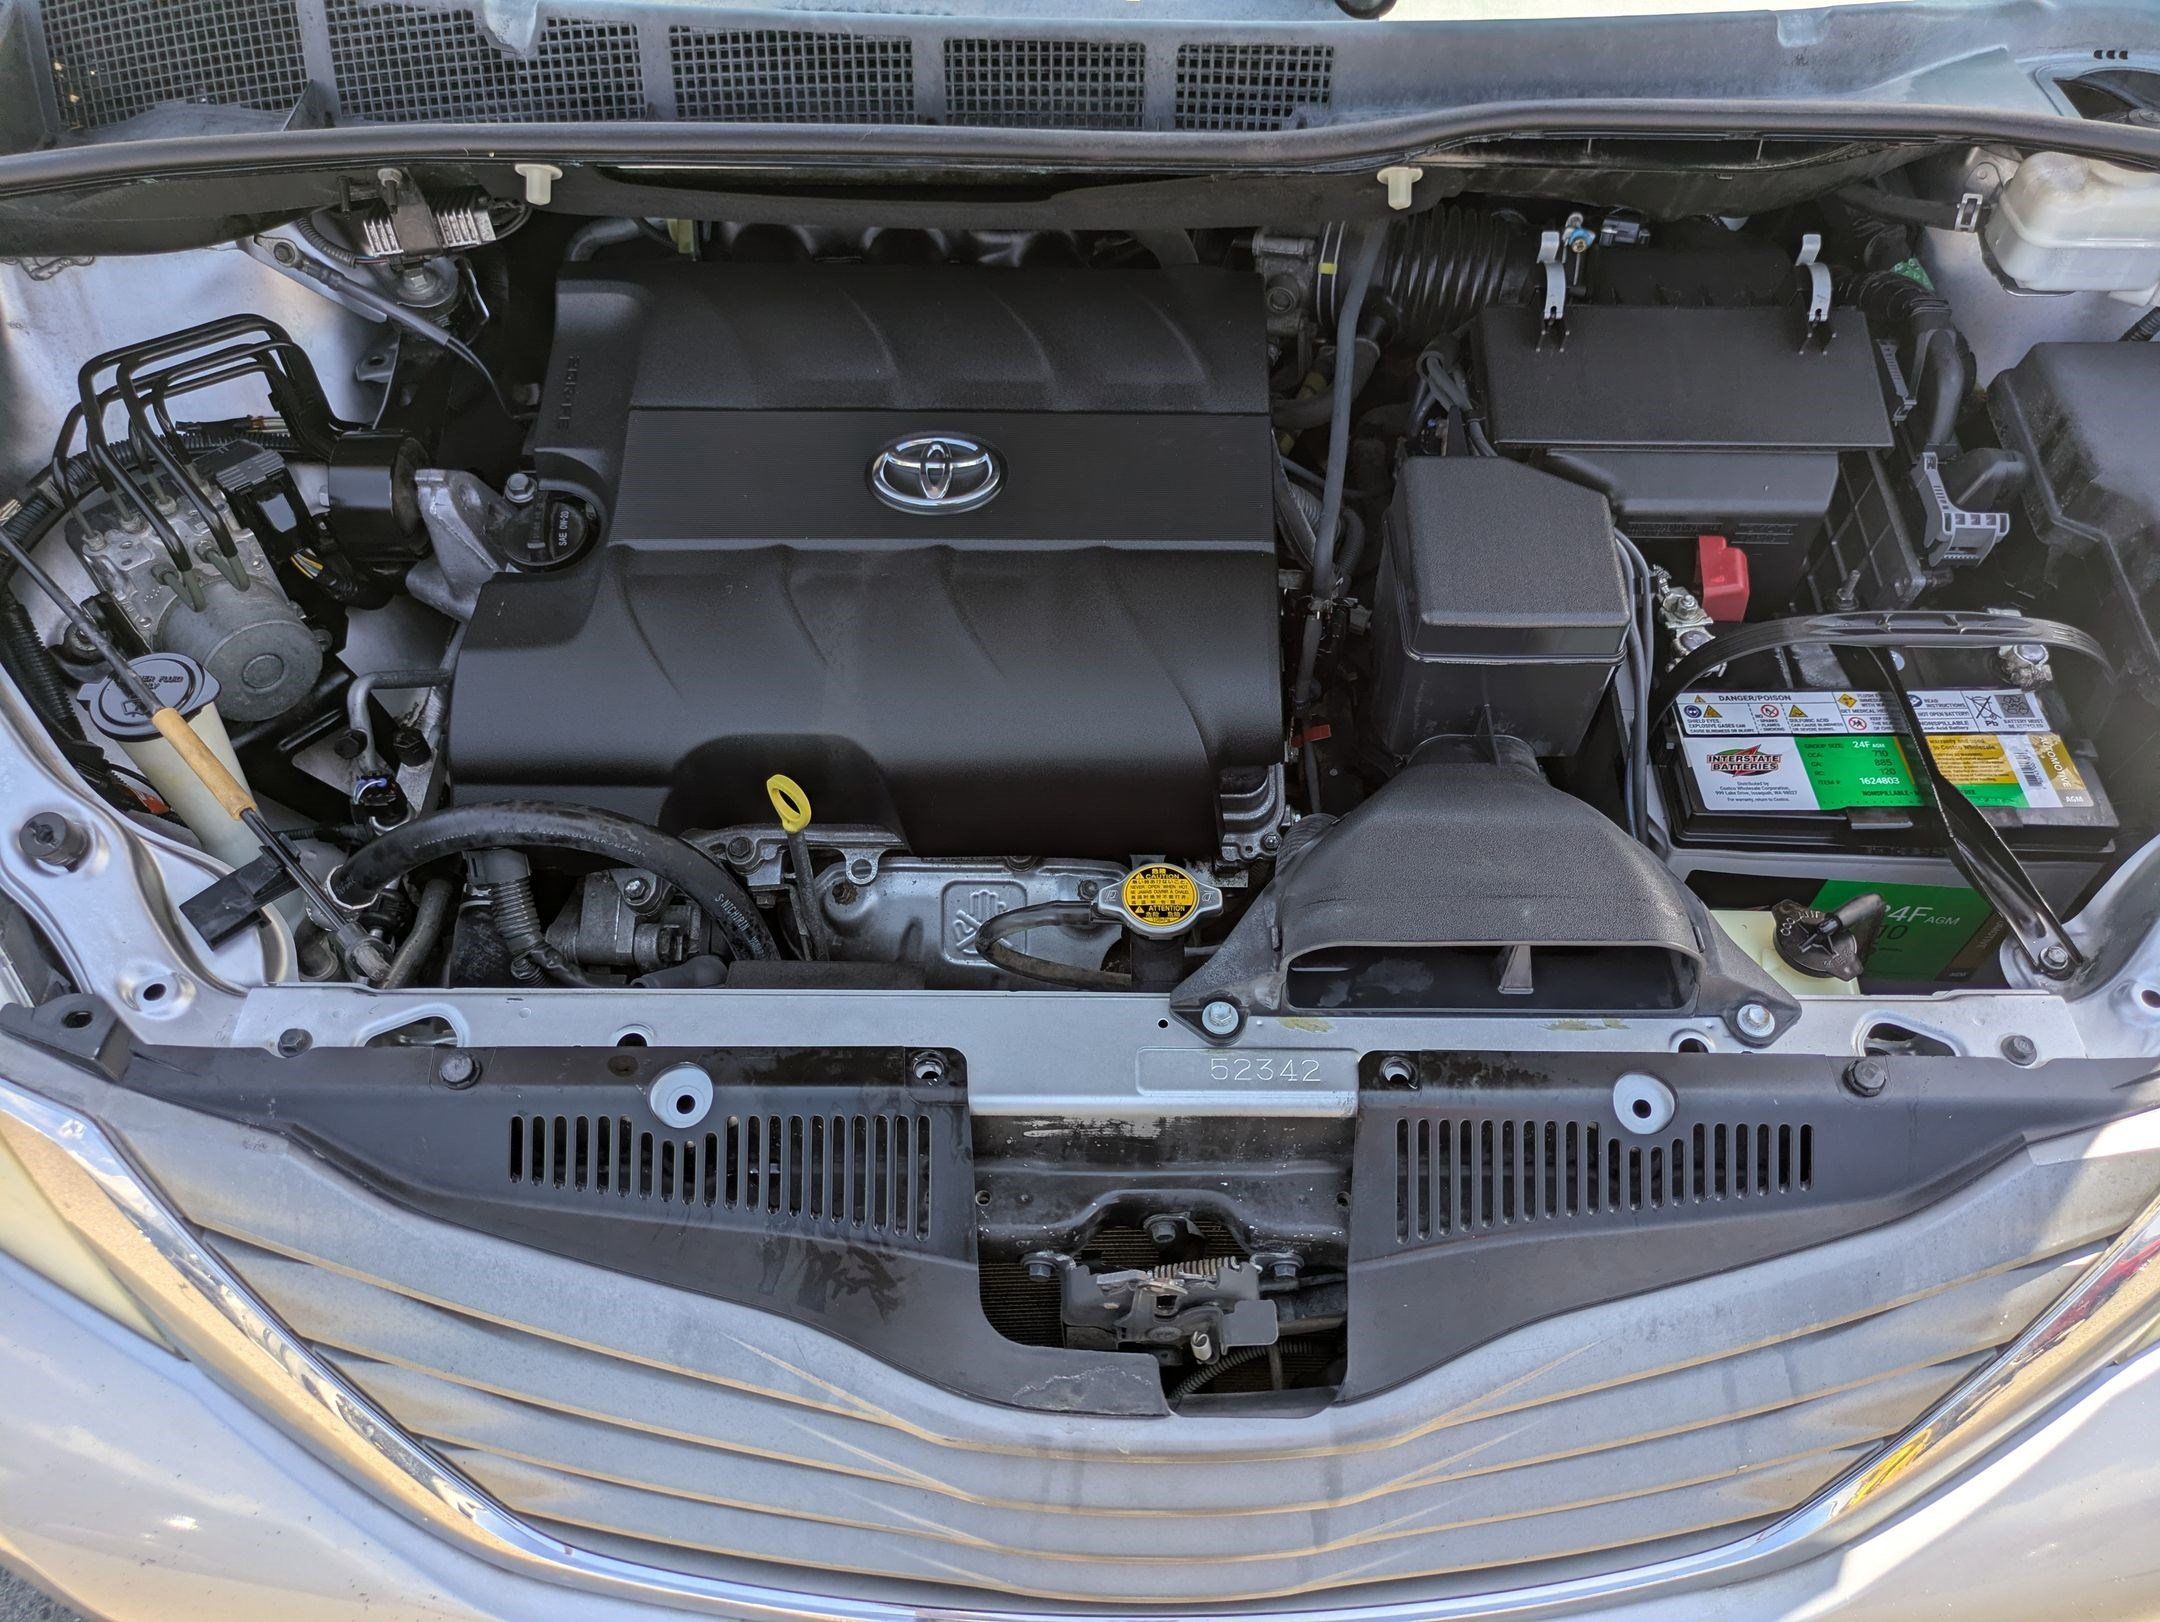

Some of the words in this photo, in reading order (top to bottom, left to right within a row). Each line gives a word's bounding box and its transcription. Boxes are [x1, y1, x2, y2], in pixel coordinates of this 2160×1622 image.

[558, 532, 568, 547] SAE
[1718, 694, 1792, 702] DANGER/POISON
[1852, 740, 1871, 749] 24F
[1873, 749, 1889, 757] 710
[1708, 754, 1781, 763] INTERSTATE
[1874, 758, 1893, 767] 885
[1712, 762, 1778, 771] BATTERIES
[1880, 767, 1897, 776] 120
[1859, 777, 1900, 785] 1624803
[1923, 915, 1961, 925] AGM
[1878, 924, 1909, 940] 10
[1210, 1058, 1322, 1082] 52342
